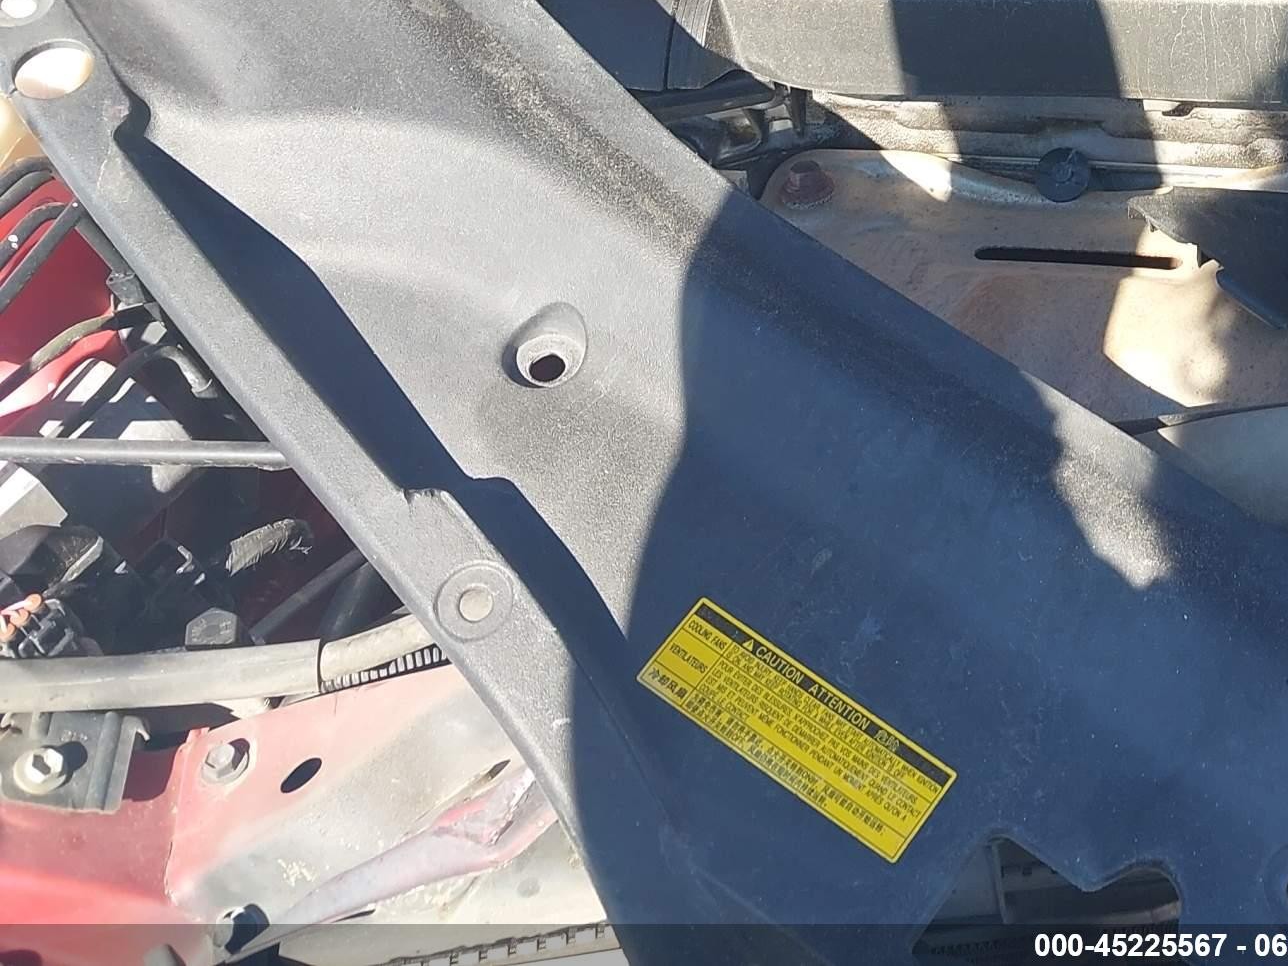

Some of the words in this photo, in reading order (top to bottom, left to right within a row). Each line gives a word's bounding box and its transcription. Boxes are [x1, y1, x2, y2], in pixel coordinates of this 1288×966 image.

[668, 642, 708, 673] VENTILATEURS
[687, 619, 713, 640] COOLING
[710, 635, 727, 650] FANS
[718, 659, 735, 674] POUR
[751, 683, 764, 695] DES
[827, 737, 840, 749] PAS
[838, 745, 852, 757] VOS
[851, 753, 869, 769] MAINS
[867, 765, 881, 778] DES
[754, 644, 805, 684] CAUTION
[807, 682, 871, 731] ATTENTION
[705, 675, 717, 686] EST
[716, 682, 728, 694] MIS
[726, 690, 736, 699] ET
[734, 695, 759, 716] PEUVENT
[773, 723, 810, 752] FONCTIONNER
[808, 748, 834, 769] PENDANT
[832, 765, 843, 776] UN
[841, 772, 865, 792] MOMENT
[711, 667, 724, 678] LES
[722, 674, 759, 703] VENTILATEURS
[757, 699, 784, 721] RISQUENT
[782, 717, 792, 727] DE
[820, 744, 869, 782] AUTOMATIQUEMENT
[867, 778, 888, 796] QUAND
[886, 791, 896, 801] LE
[894, 797, 920, 818] CONTACT
[861, 736, 901, 767] AUTOMATICALLY
[900, 763, 917, 778] WHEN
[915, 775, 939, 794] IGNITION
